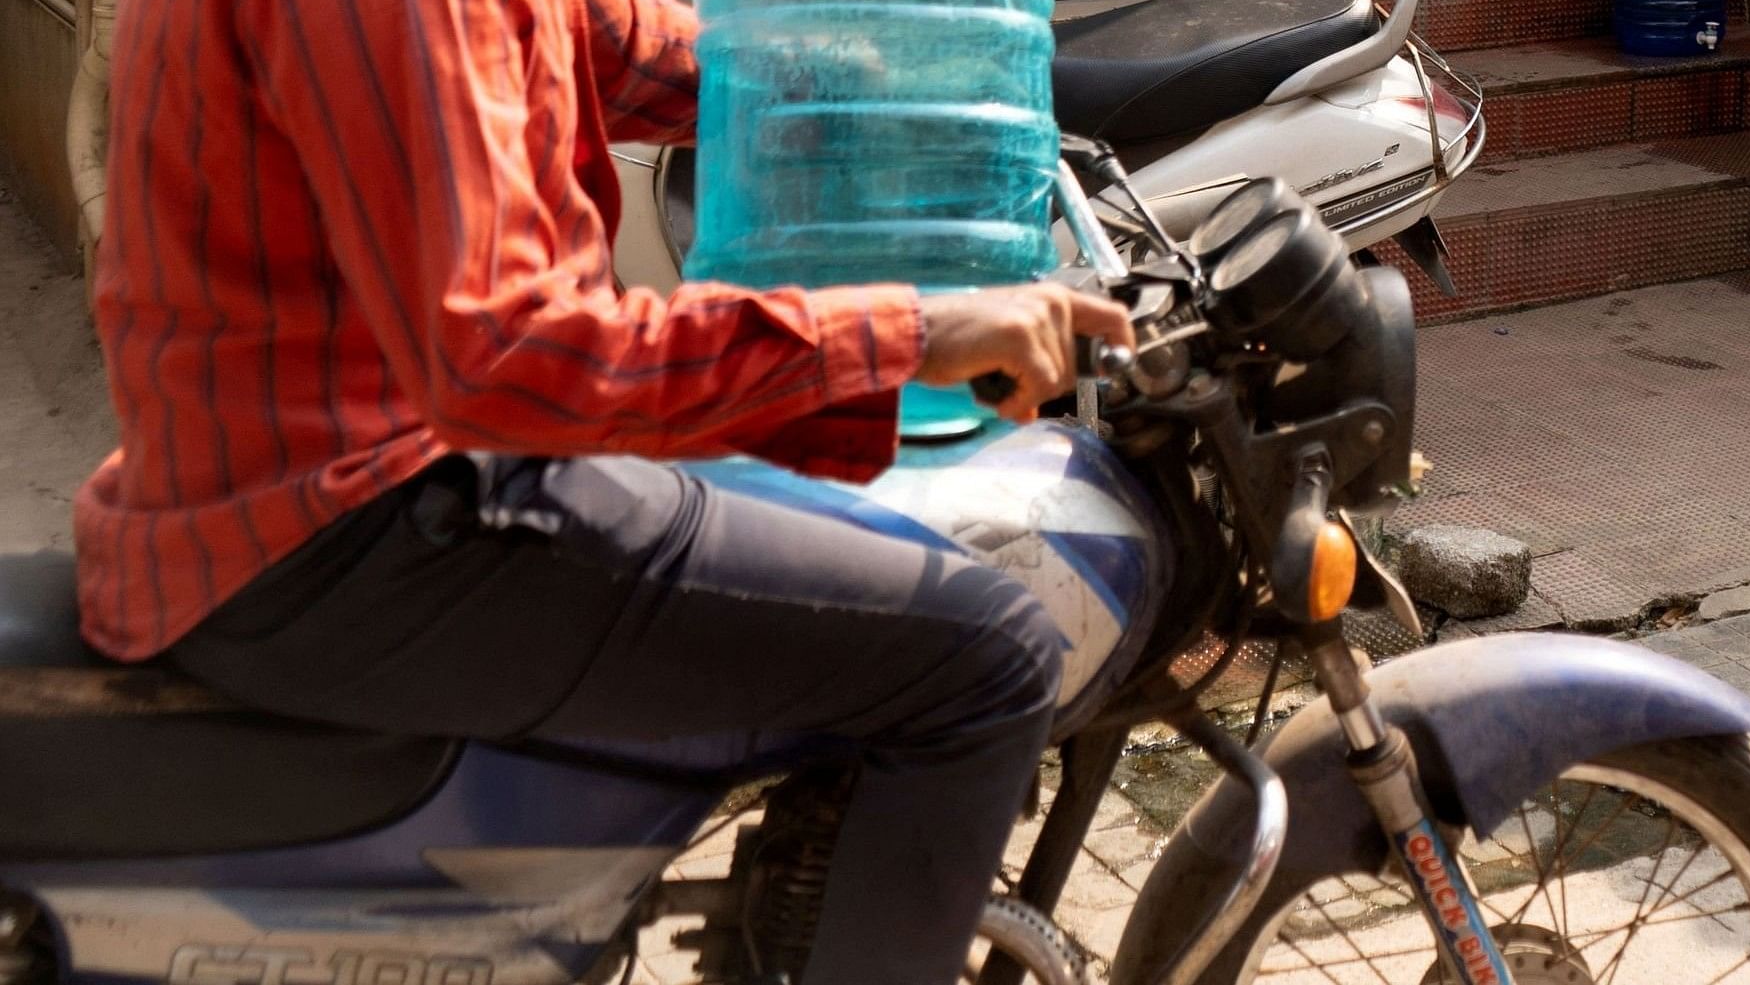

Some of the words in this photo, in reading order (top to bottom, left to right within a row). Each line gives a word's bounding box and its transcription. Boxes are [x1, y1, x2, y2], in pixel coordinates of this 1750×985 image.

[1323, 195, 1375, 218] LIMITED
[1378, 175, 1427, 199] EDITION
[1406, 833, 1469, 933] QUICK
[1455, 934, 1502, 985] BIK
